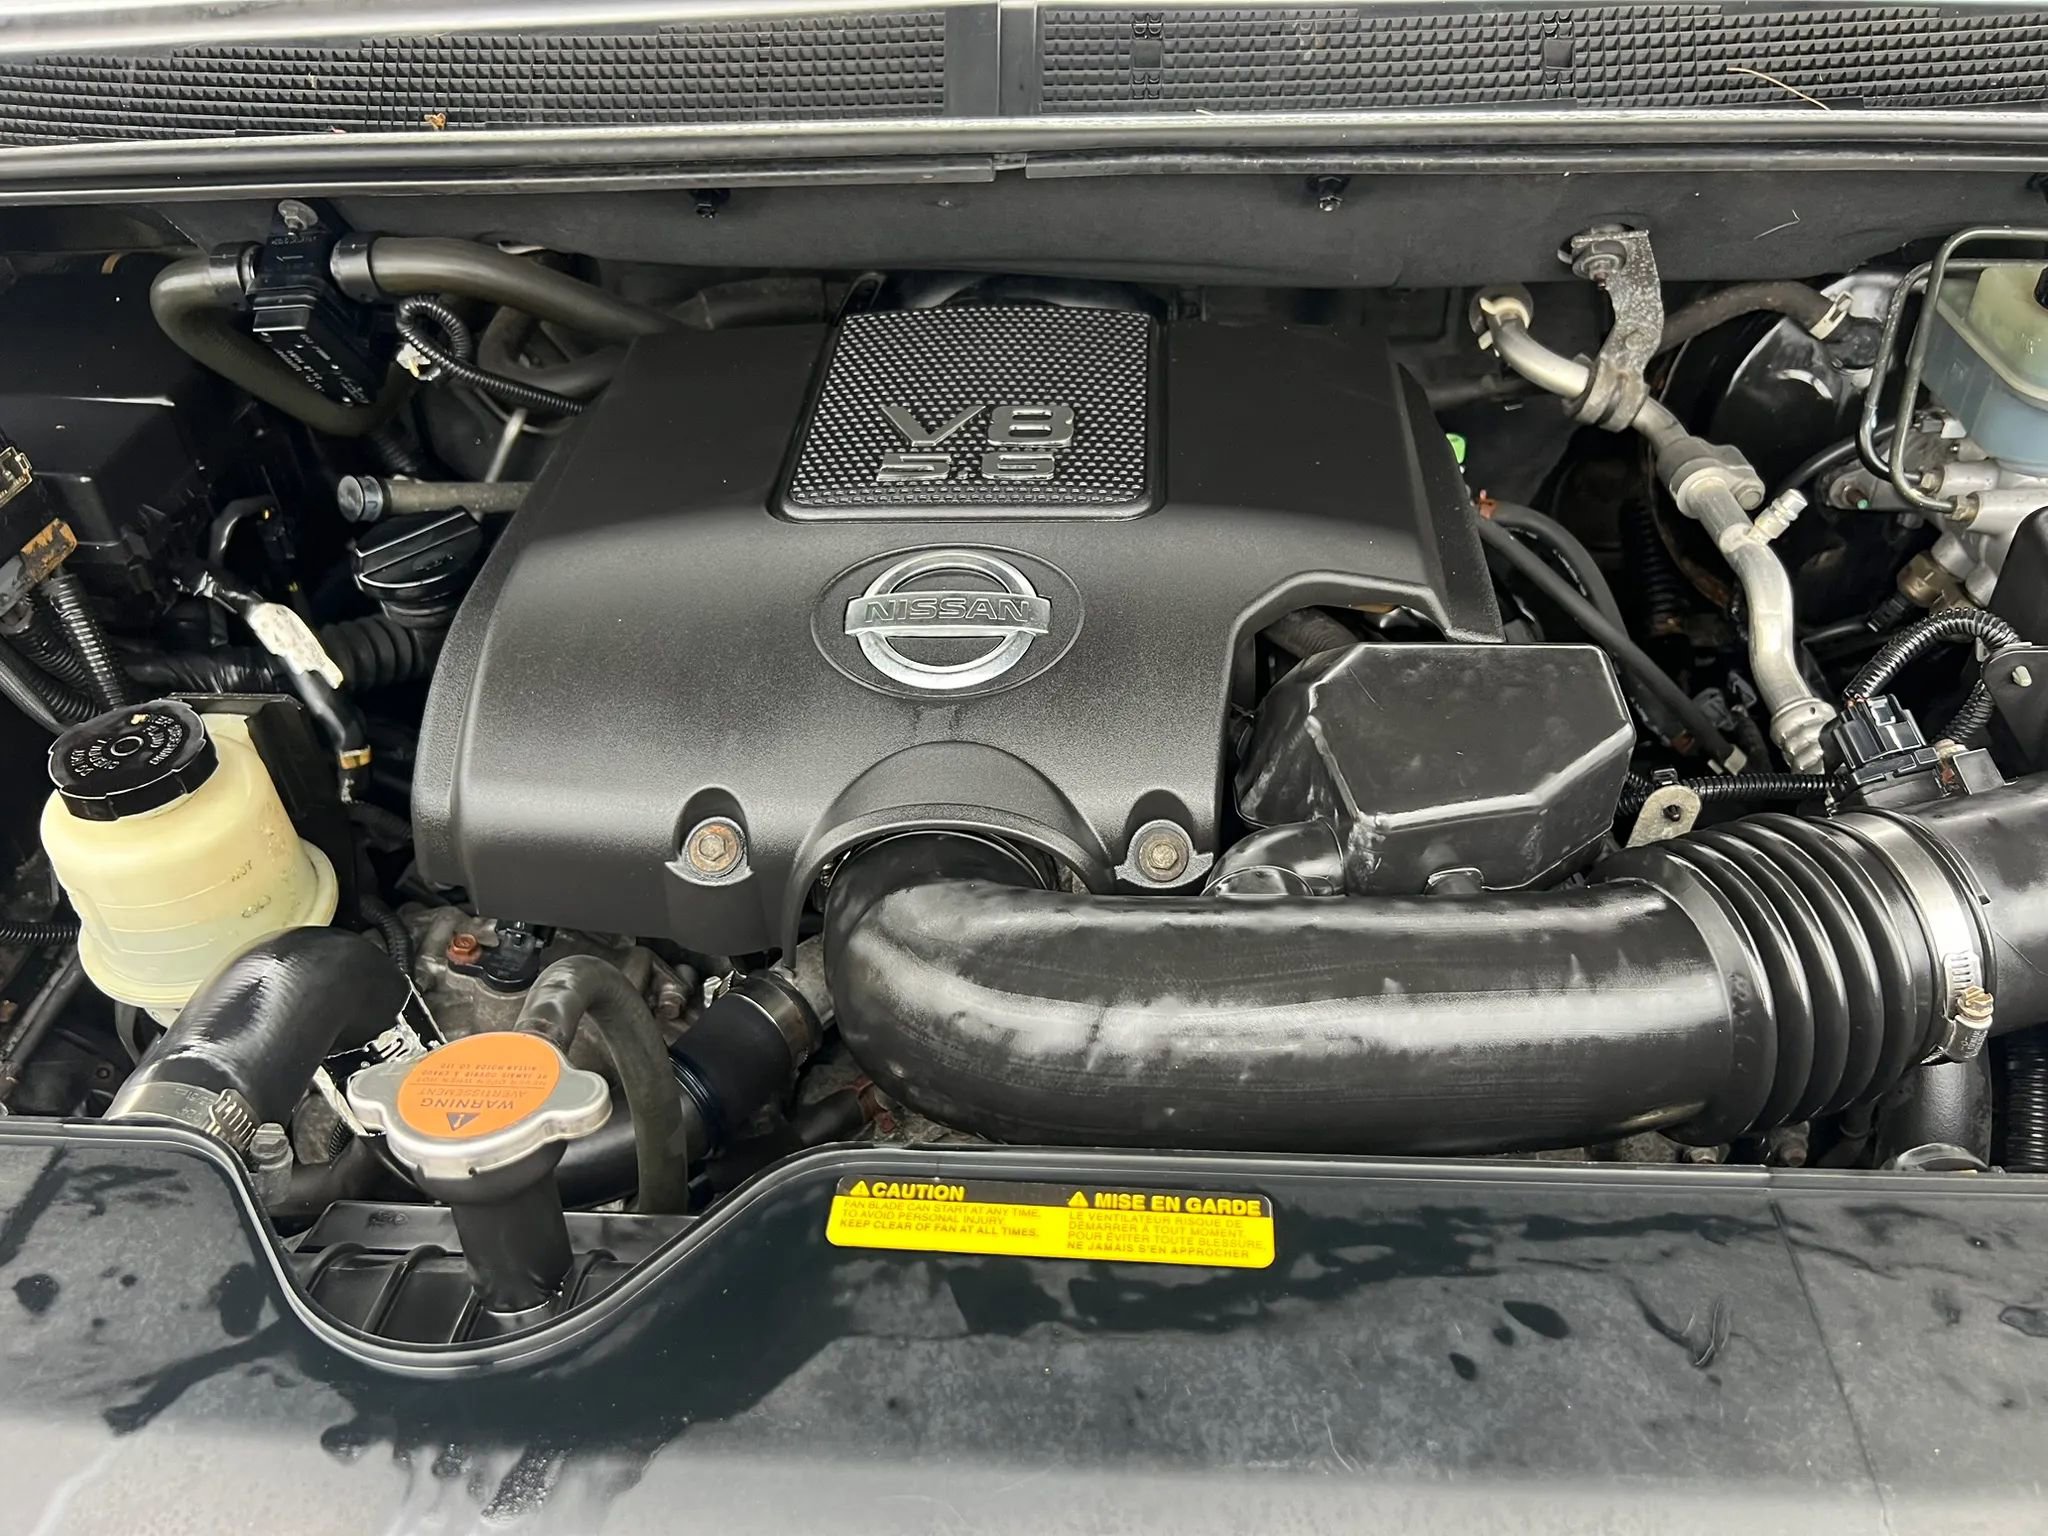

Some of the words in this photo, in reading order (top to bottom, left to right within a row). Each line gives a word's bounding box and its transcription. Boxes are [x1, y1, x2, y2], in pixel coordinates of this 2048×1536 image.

[879, 405, 1075, 447] V8
[876, 450, 1056, 481] 5.6
[864, 597, 1031, 623] NISSAN
[419, 1087, 528, 1098] AVERTISSEMENT
[420, 1097, 514, 1109] WARNING
[871, 1182, 966, 1201] CAUTION
[844, 1201, 865, 1209] FAN
[868, 1202, 903, 1211] BLADE
[907, 1203, 930, 1211] CAN
[934, 1204, 969, 1213] START
[984, 1206, 1008, 1216] ANY
[1094, 1192, 1146, 1210] MISE
[1151, 1195, 1181, 1212] EN
[1185, 1197, 1261, 1216] GARDE
[842, 1210, 858, 1218] TO
[860, 1210, 895, 1220] AVOID
[898, 1212, 960, 1223] PERSONAL
[1069, 1212, 1083, 1221] LE
[1088, 1212, 1171, 1225] VENTILATEUR
[1175, 1216, 1221, 1228] RISQUE
[1226, 1219, 1242, 1229] DE
[840, 1219, 871, 1229] KEEP
[873, 1221, 912, 1231] CLEAR
[915, 1222, 931, 1231] OF
[934, 1223, 956, 1233] FAN
[960, 1225, 974, 1234] AT
[976, 1225, 998, 1235] ALL
[1002, 1227, 1039, 1237] TIMES.
[1154, 1225, 1185, 1235] TOUT
[1068, 1231, 1102, 1241] POUR
[1153, 1234, 1194, 1246] TOUTE
[1067, 1242, 1083, 1250] NE
[1088, 1243, 1134, 1253] JAMAIS
[1171, 1247, 1249, 1259] APPROCHER
